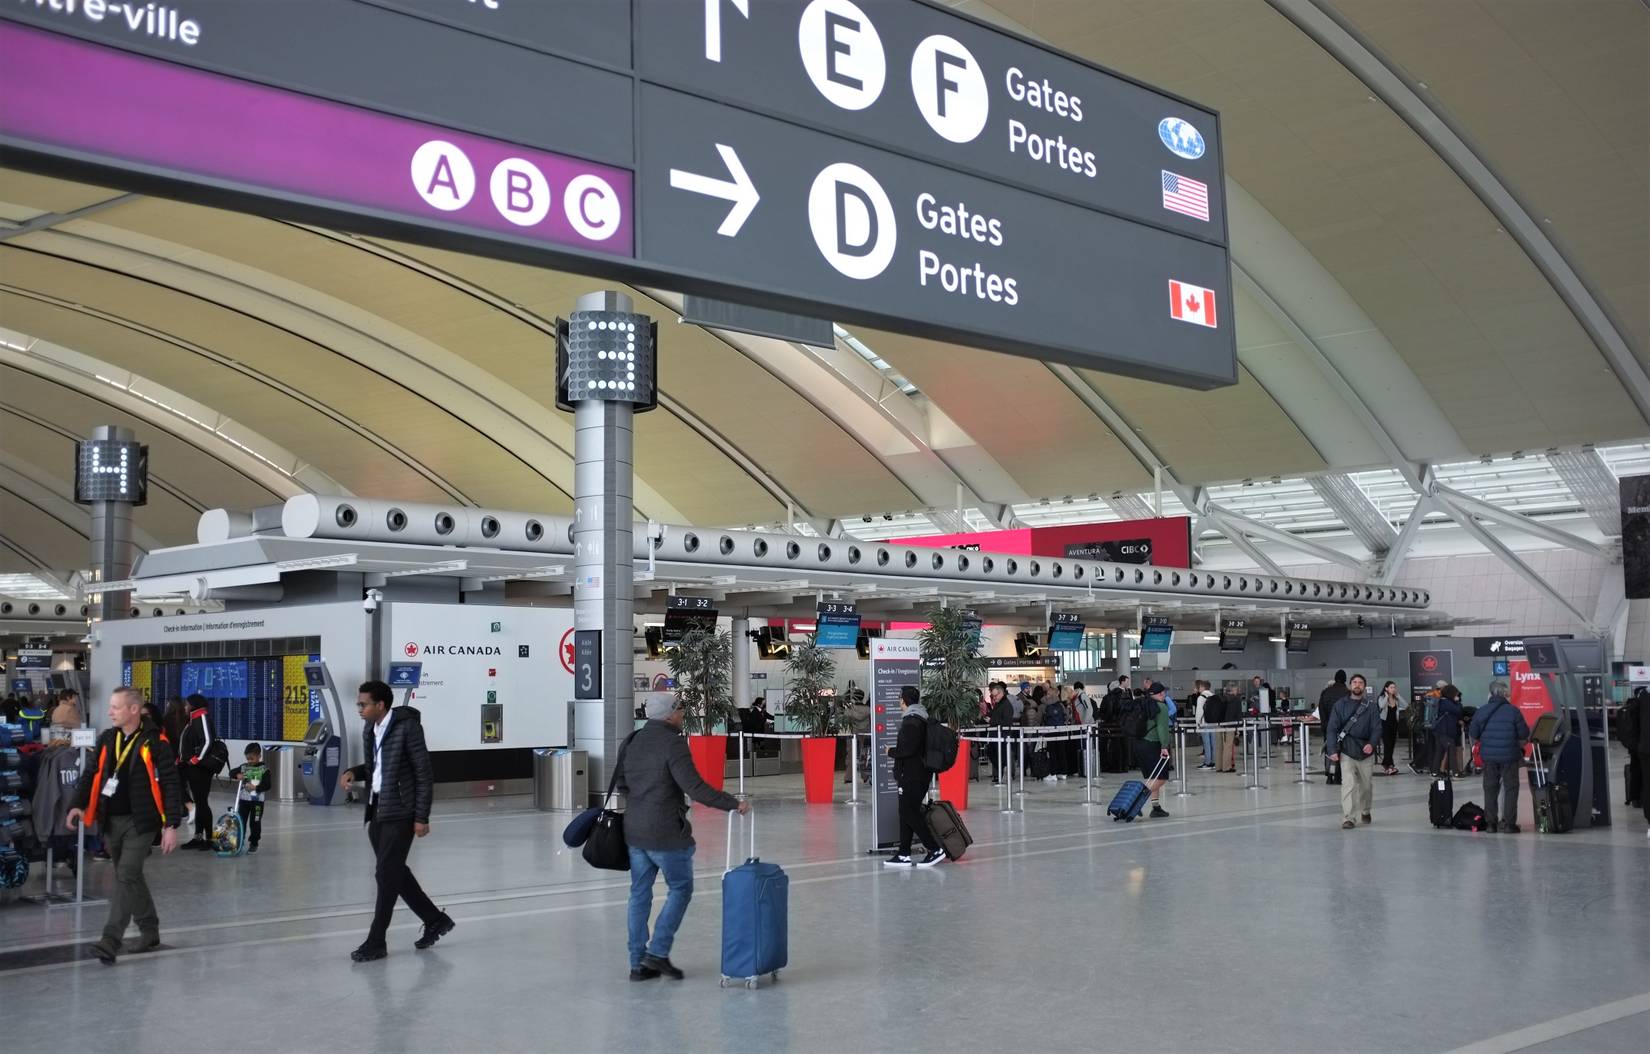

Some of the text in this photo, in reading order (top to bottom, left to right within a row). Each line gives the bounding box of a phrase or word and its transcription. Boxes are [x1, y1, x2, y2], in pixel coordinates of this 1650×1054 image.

[825, 9, 967, 118] E F
[1006, 66, 1083, 122] Gates
[1008, 119, 1097, 178] Portes
[426, 154, 605, 229] A B C
[834, 179, 879, 258] D
[916, 192, 1003, 247] Gates
[919, 249, 1019, 306] Portes
[588, 321, 635, 391] 3
[92, 446, 128, 494] 4
[1068, 548, 1101, 556] AVENTURA
[1121, 545, 1140, 555] CIBC
[423, 645, 501, 656] AIR CANADA
[581, 663, 592, 692] 3
[1515, 671, 1541, 684] Lynx
[285, 685, 307, 705] 215
